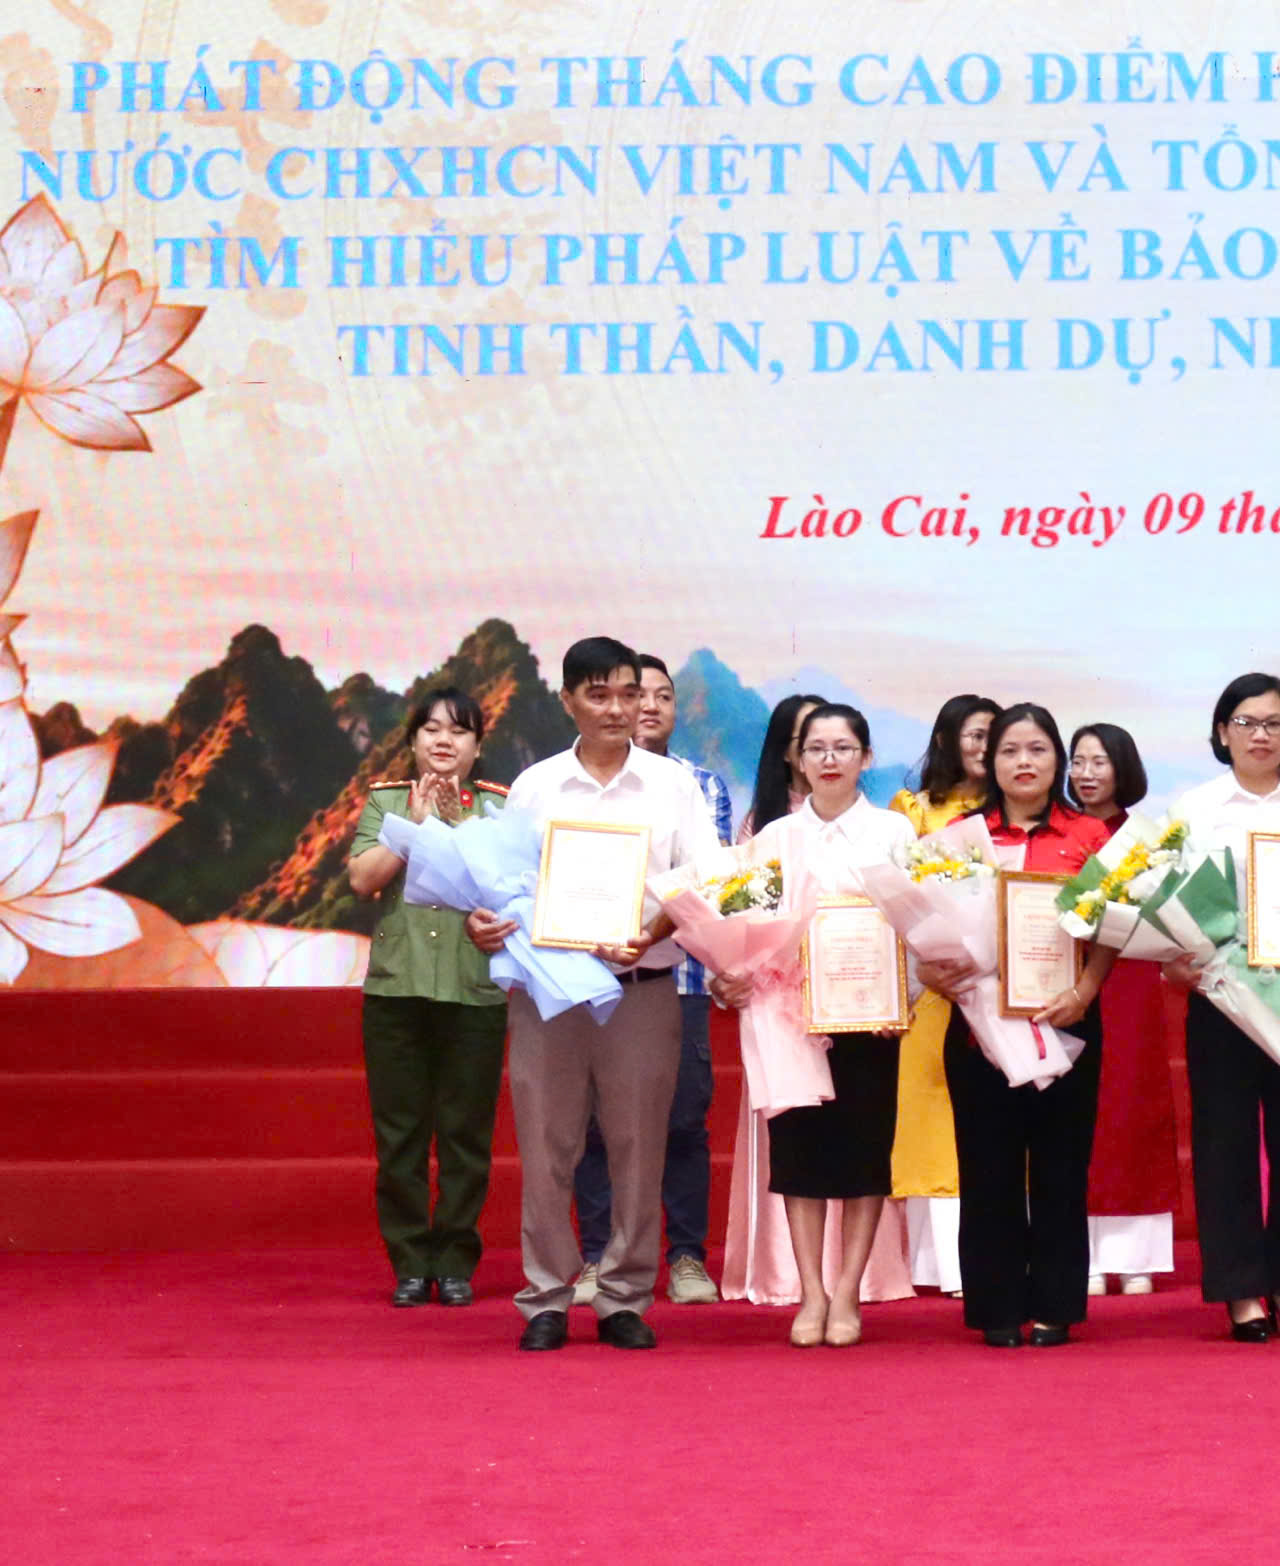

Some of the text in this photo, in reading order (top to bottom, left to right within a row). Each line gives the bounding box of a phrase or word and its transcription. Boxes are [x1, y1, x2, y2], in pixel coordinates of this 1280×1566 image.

[70, 43, 276, 114] PHÁT
[295, 51, 518, 126] ĐỘNG
[540, 38, 815, 110] THÁNG
[838, 53, 1002, 107] CAO
[1025, 35, 1228, 105] ĐIỂM
[18, 130, 243, 204] NƯỚC
[265, 144, 602, 202] CHXHCN
[621, 134, 802, 211] VIỆT
[825, 141, 998, 195] NAM
[1023, 122, 1130, 194] VÀ
[153, 218, 302, 290] TÌM
[327, 217, 516, 290] HIỂU
[542, 214, 747, 288] PHÁP
[763, 219, 970, 299] LUẬT
[990, 211, 1092, 283] VỀ
[1116, 211, 1280, 283] BẢO
[336, 322, 527, 378] TINH
[548, 303, 786, 384] THẦN,
[810, 318, 1028, 374] DANH
[1054, 306, 1188, 386] DỰ,
[758, 492, 864, 540] Lào
[880, 492, 981, 545] Cai,
[999, 490, 1128, 549] ngày
[1142, 490, 1207, 536] 09
